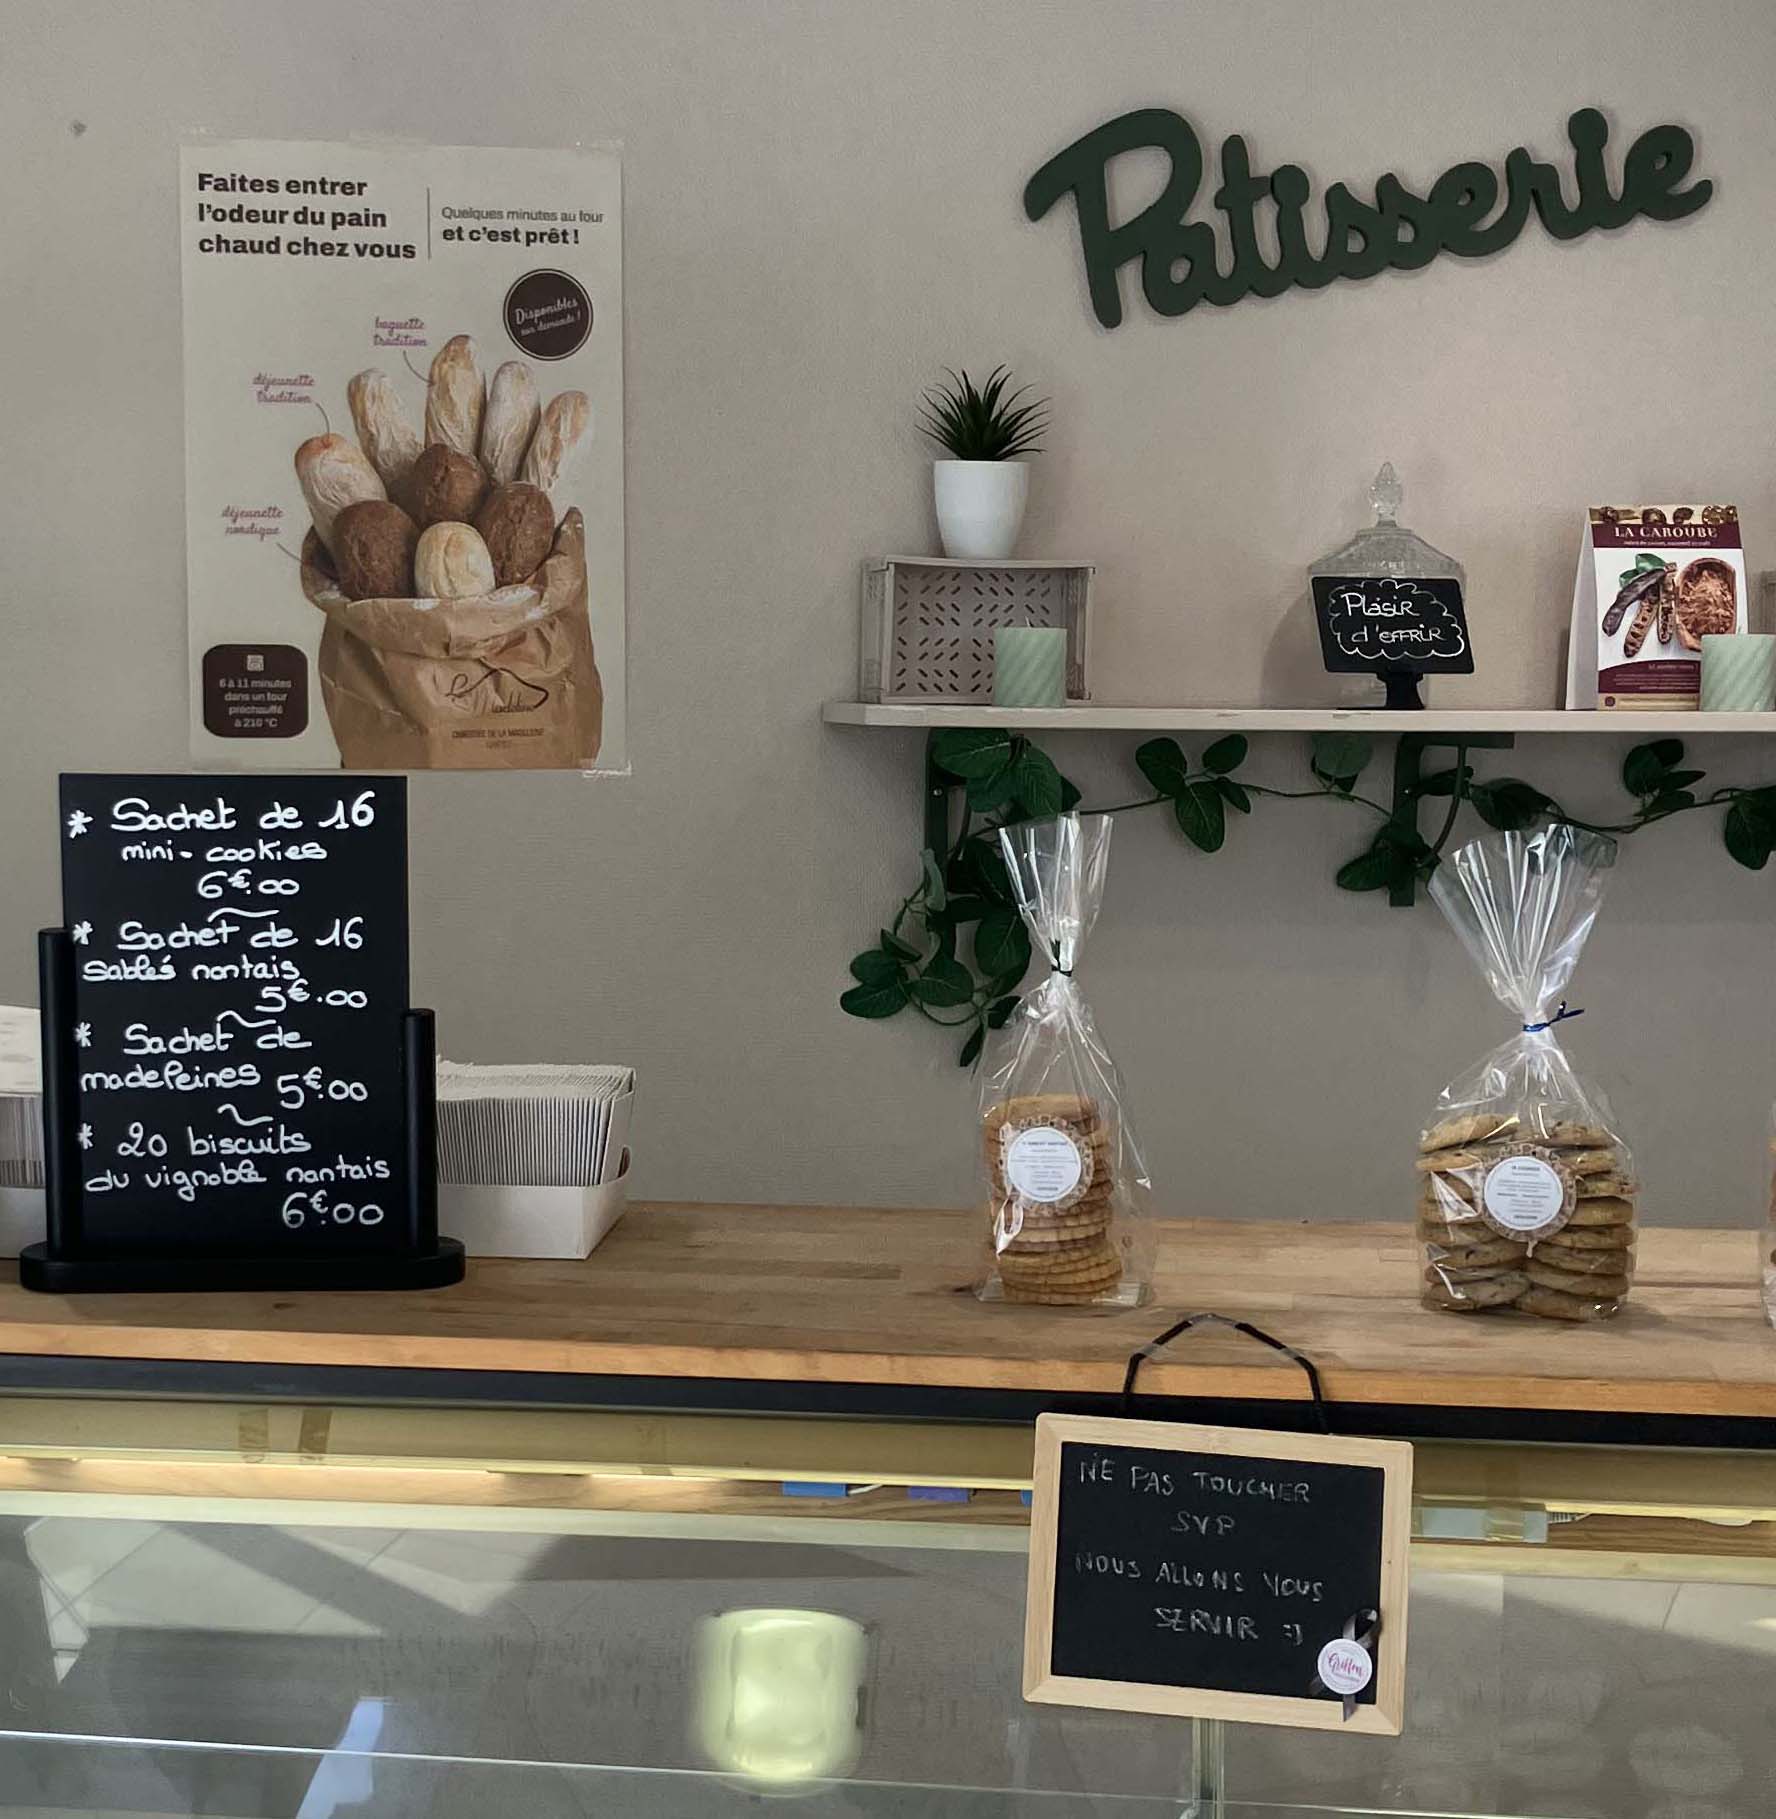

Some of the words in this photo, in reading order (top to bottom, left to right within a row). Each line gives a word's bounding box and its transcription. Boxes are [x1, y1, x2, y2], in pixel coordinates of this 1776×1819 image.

[198, 172, 280, 193] Faites
[285, 177, 367, 196] entrer
[293, 206, 325, 226] du
[331, 208, 387, 230] pain
[441, 206, 504, 221] Quelques
[506, 209, 557, 222] minutes
[560, 211, 576, 222] au
[579, 210, 604, 223] four
[1025, 107, 1713, 329] Patisserie
[442, 226, 465, 242] et
[198, 234, 281, 255] chaud
[286, 237, 349, 257] chez
[354, 243, 416, 259] vous
[515, 297, 578, 325] Disponibles
[375, 316, 425, 337] baguette
[373, 333, 428, 346] tradition
[252, 371, 315, 391] déjeunette
[257, 391, 312, 403] tradition
[221, 505, 284, 524] déjeunette
[225, 522, 281, 541] nordique
[1615, 527, 1634, 537] LA
[1640, 526, 1718, 538] CAROUBE
[238, 679, 249, 688] 11
[251, 679, 292, 688] minutes
[224, 692, 250, 701] dans
[252, 693, 266, 701] un
[267, 692, 288, 701] four
[229, 704, 283, 715] préchauffé
[110, 797, 237, 832] Sachet
[258, 801, 304, 830] de
[317, 791, 375, 829] 16
[205, 839, 328, 862] cookies
[117, 918, 241, 951] Sachet
[249, 921, 299, 950] de
[314, 916, 364, 950] 16
[191, 954, 300, 981] nantais
[123, 1021, 234, 1055] Sachet
[255, 1025, 313, 1050] de
[80, 1060, 261, 1093] madeleines
[117, 1121, 168, 1158] 20
[186, 1124, 312, 1157] biscuits
[84, 1169, 130, 1193] du
[144, 1158, 267, 1202] vignoble
[285, 1153, 391, 1185] nantais
[1079, 1452, 1116, 1484] NE
[1130, 1465, 1176, 1497] PAS
[1191, 1470, 1312, 1503] TOUCHER
[1170, 1509, 1236, 1536] SVP
[1074, 1552, 1142, 1579] NOUS
[1155, 1561, 1245, 1593] ALLONS
[1262, 1571, 1324, 1602] VOUS
[1152, 1607, 1259, 1640] SERVIR
